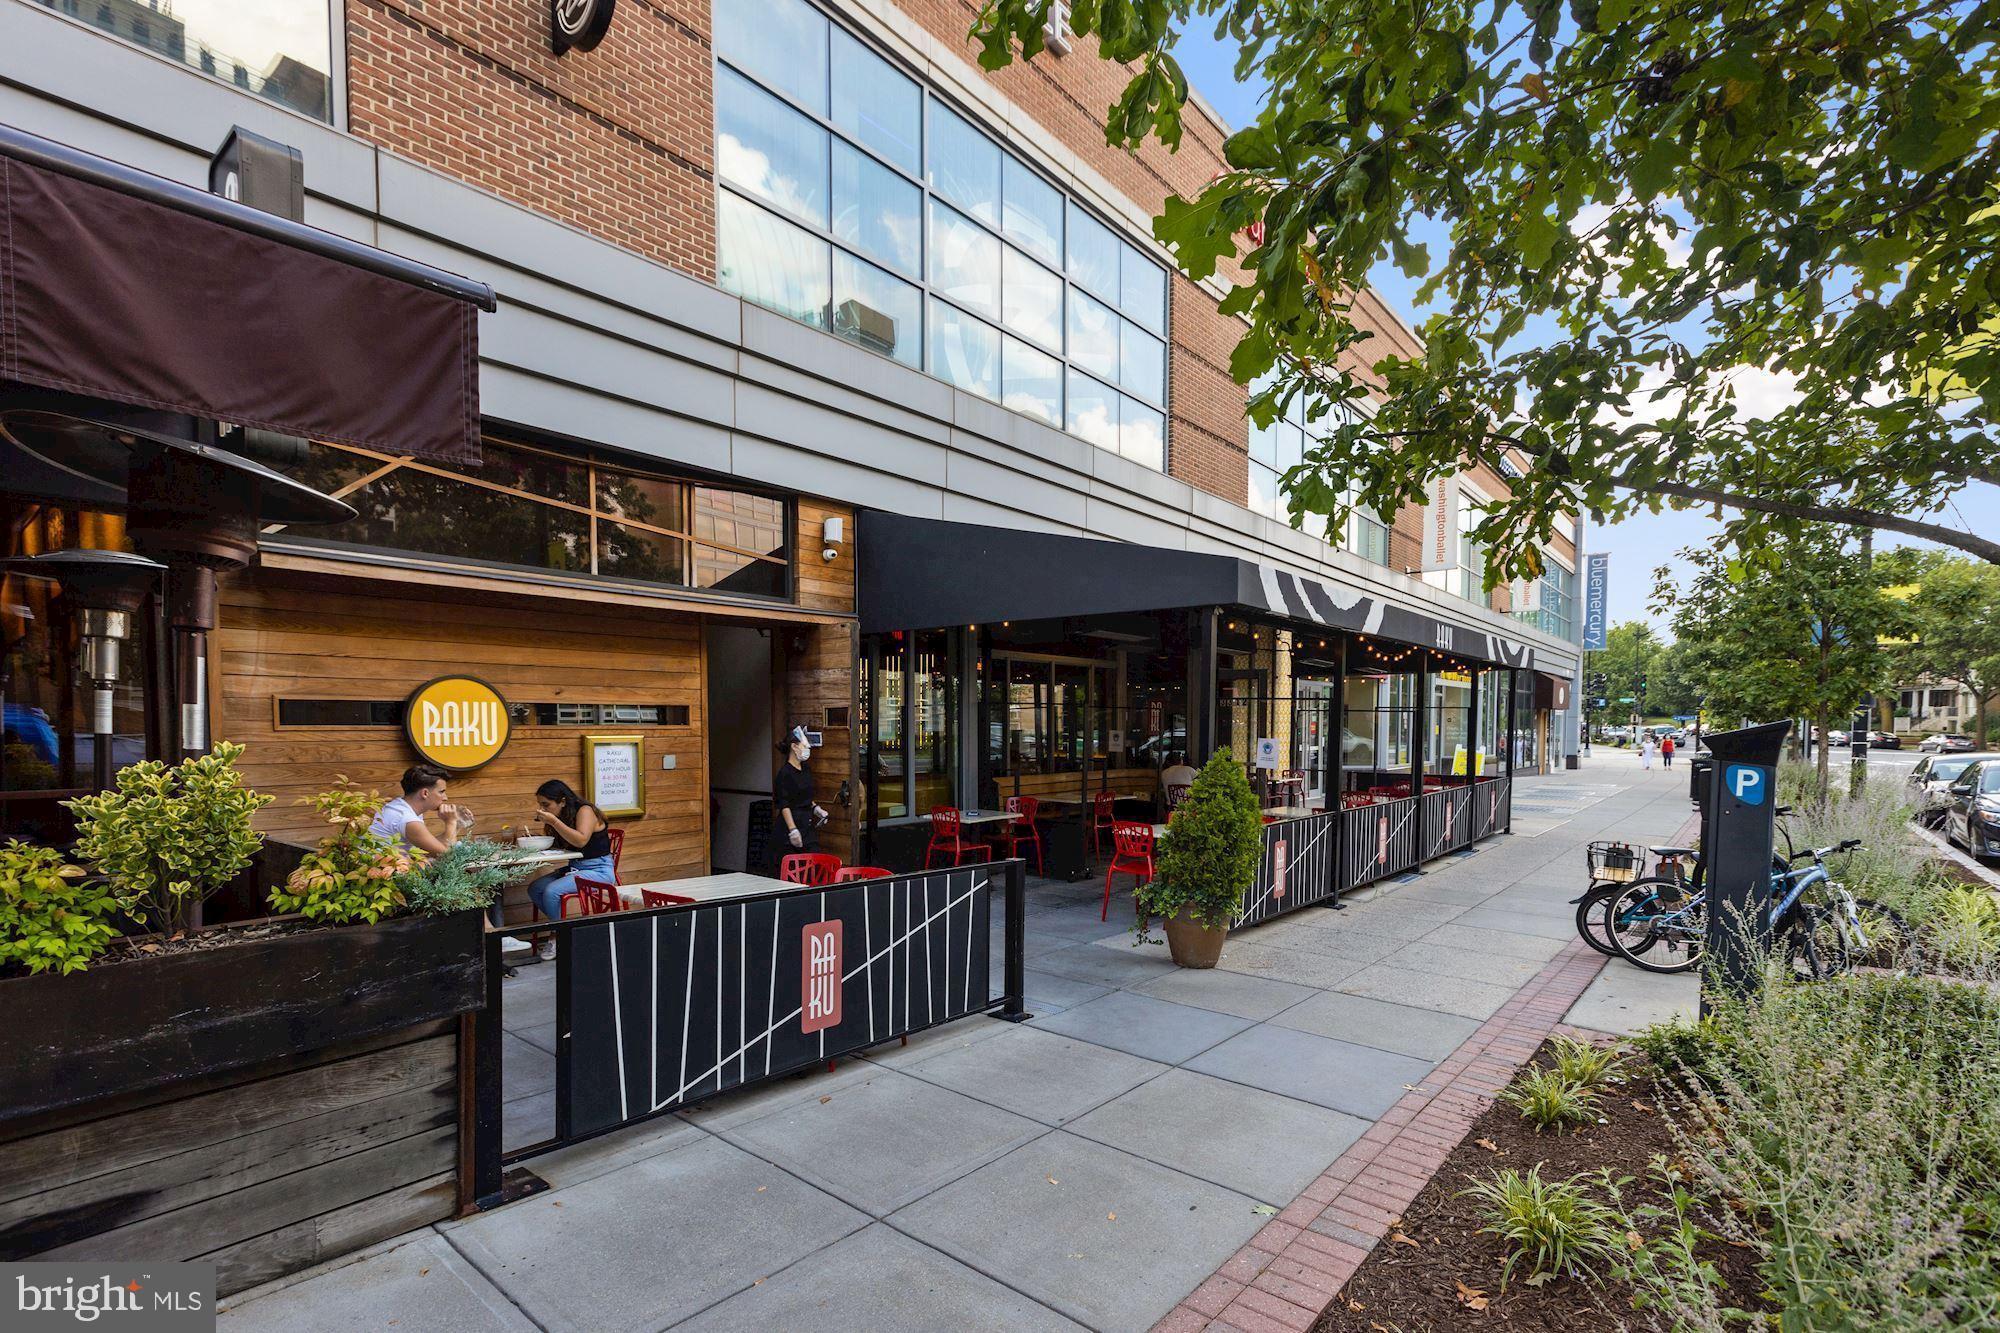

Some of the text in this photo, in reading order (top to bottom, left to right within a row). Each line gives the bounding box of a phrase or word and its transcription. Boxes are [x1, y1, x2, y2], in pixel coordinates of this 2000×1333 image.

[1435, 478, 1447, 564] washingtonballet
[1585, 557, 1608, 645] bluemercury
[422, 700, 498, 747] RAKU
[1735, 768, 1760, 797] P
